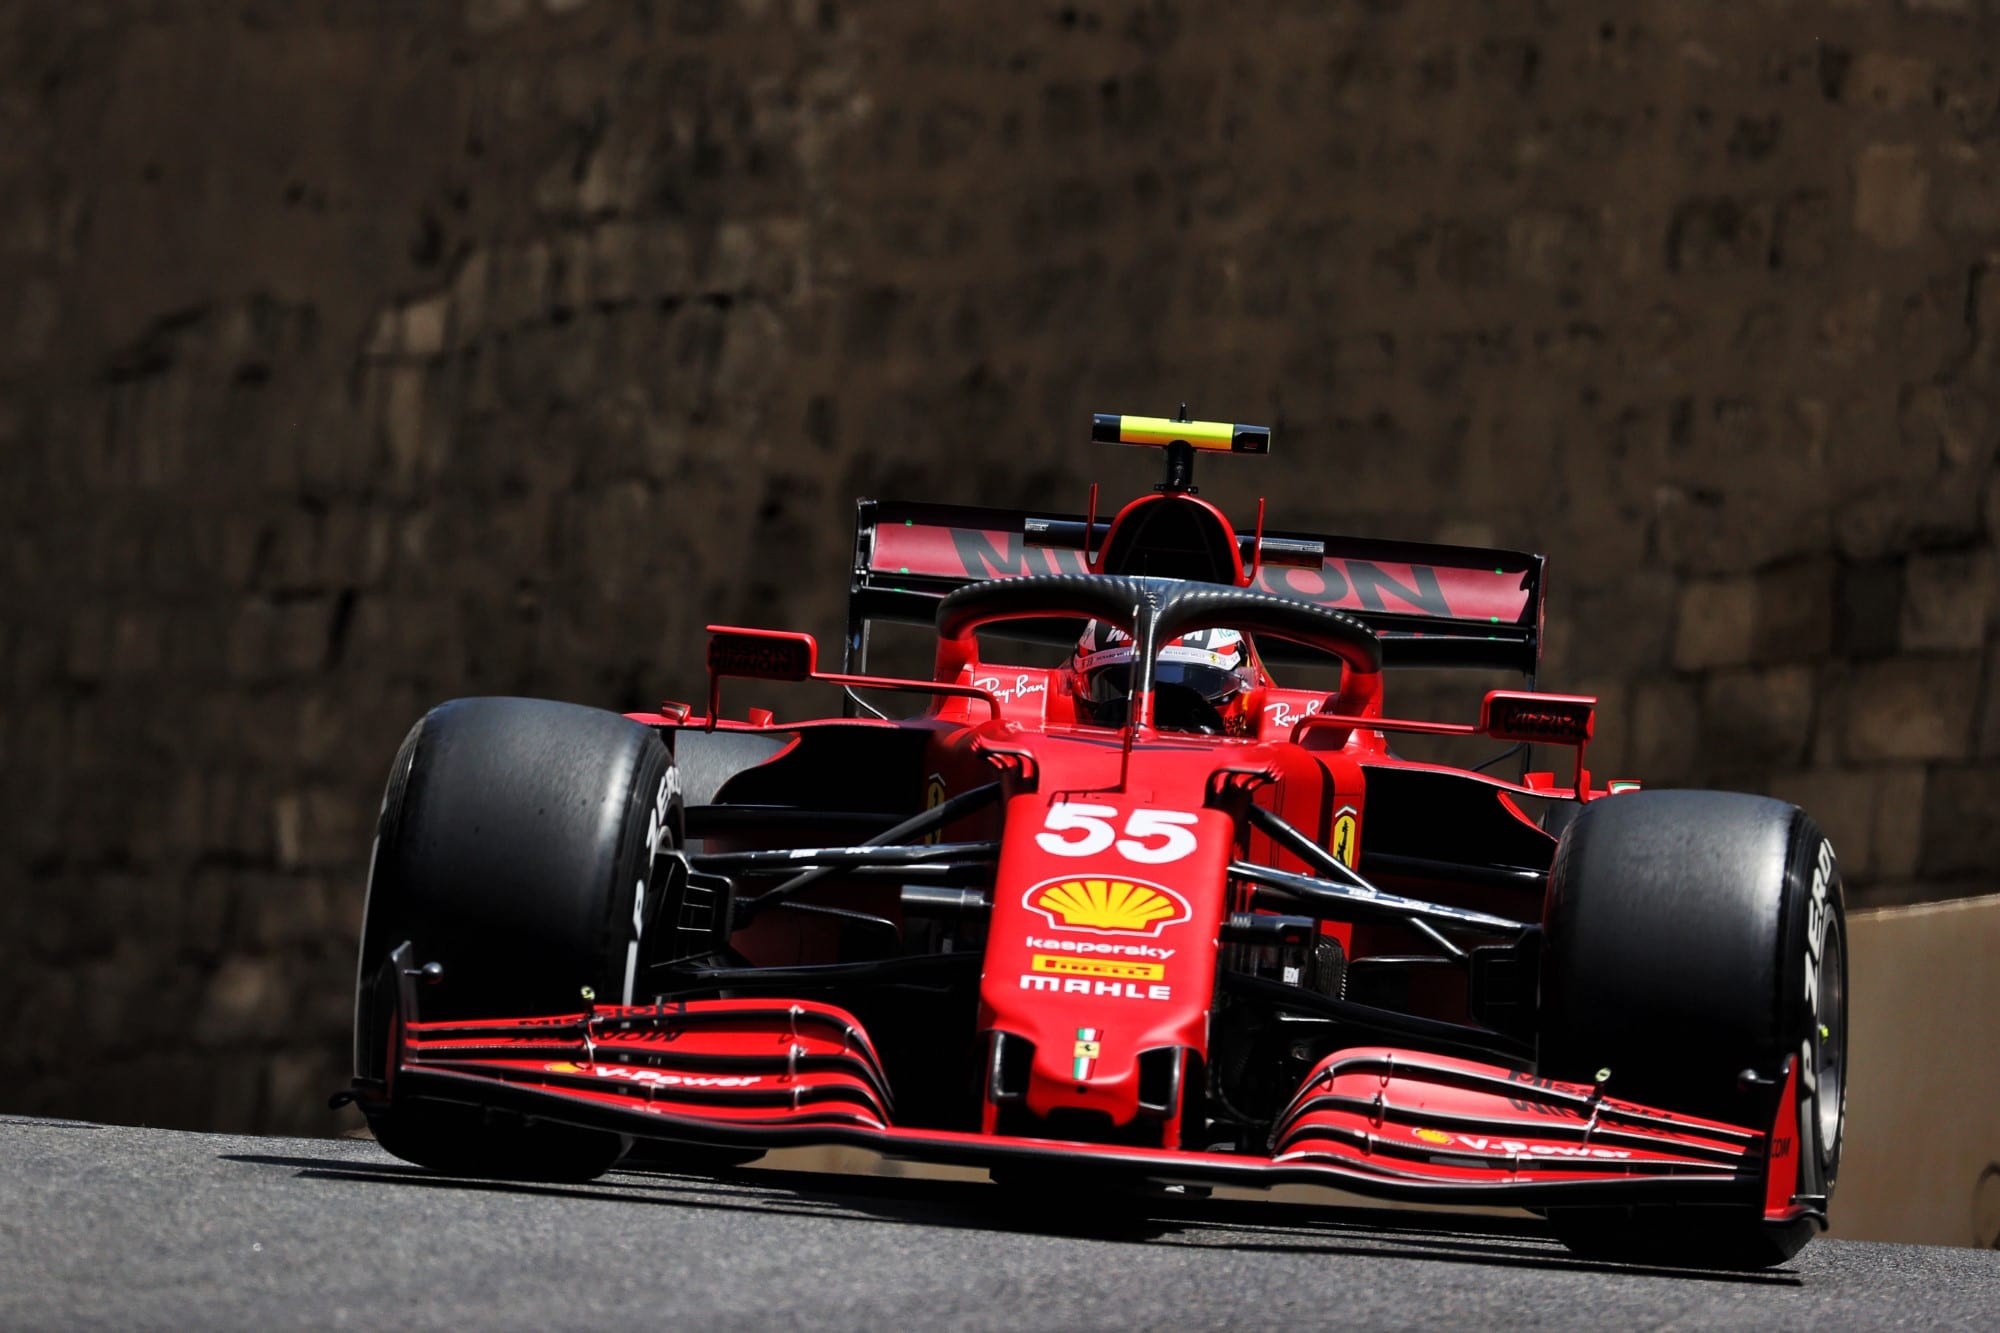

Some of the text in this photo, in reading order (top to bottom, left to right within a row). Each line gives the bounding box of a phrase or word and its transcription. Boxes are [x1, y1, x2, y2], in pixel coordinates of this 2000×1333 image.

[946, 527, 1453, 619] MION
[1035, 801, 1198, 864] 55
[1025, 936, 1176, 959] kaspersky
[1019, 974, 1171, 1001] MAHLE
[595, 1066, 762, 1087] V-Power
[1457, 1136, 1633, 1159] V-Power
